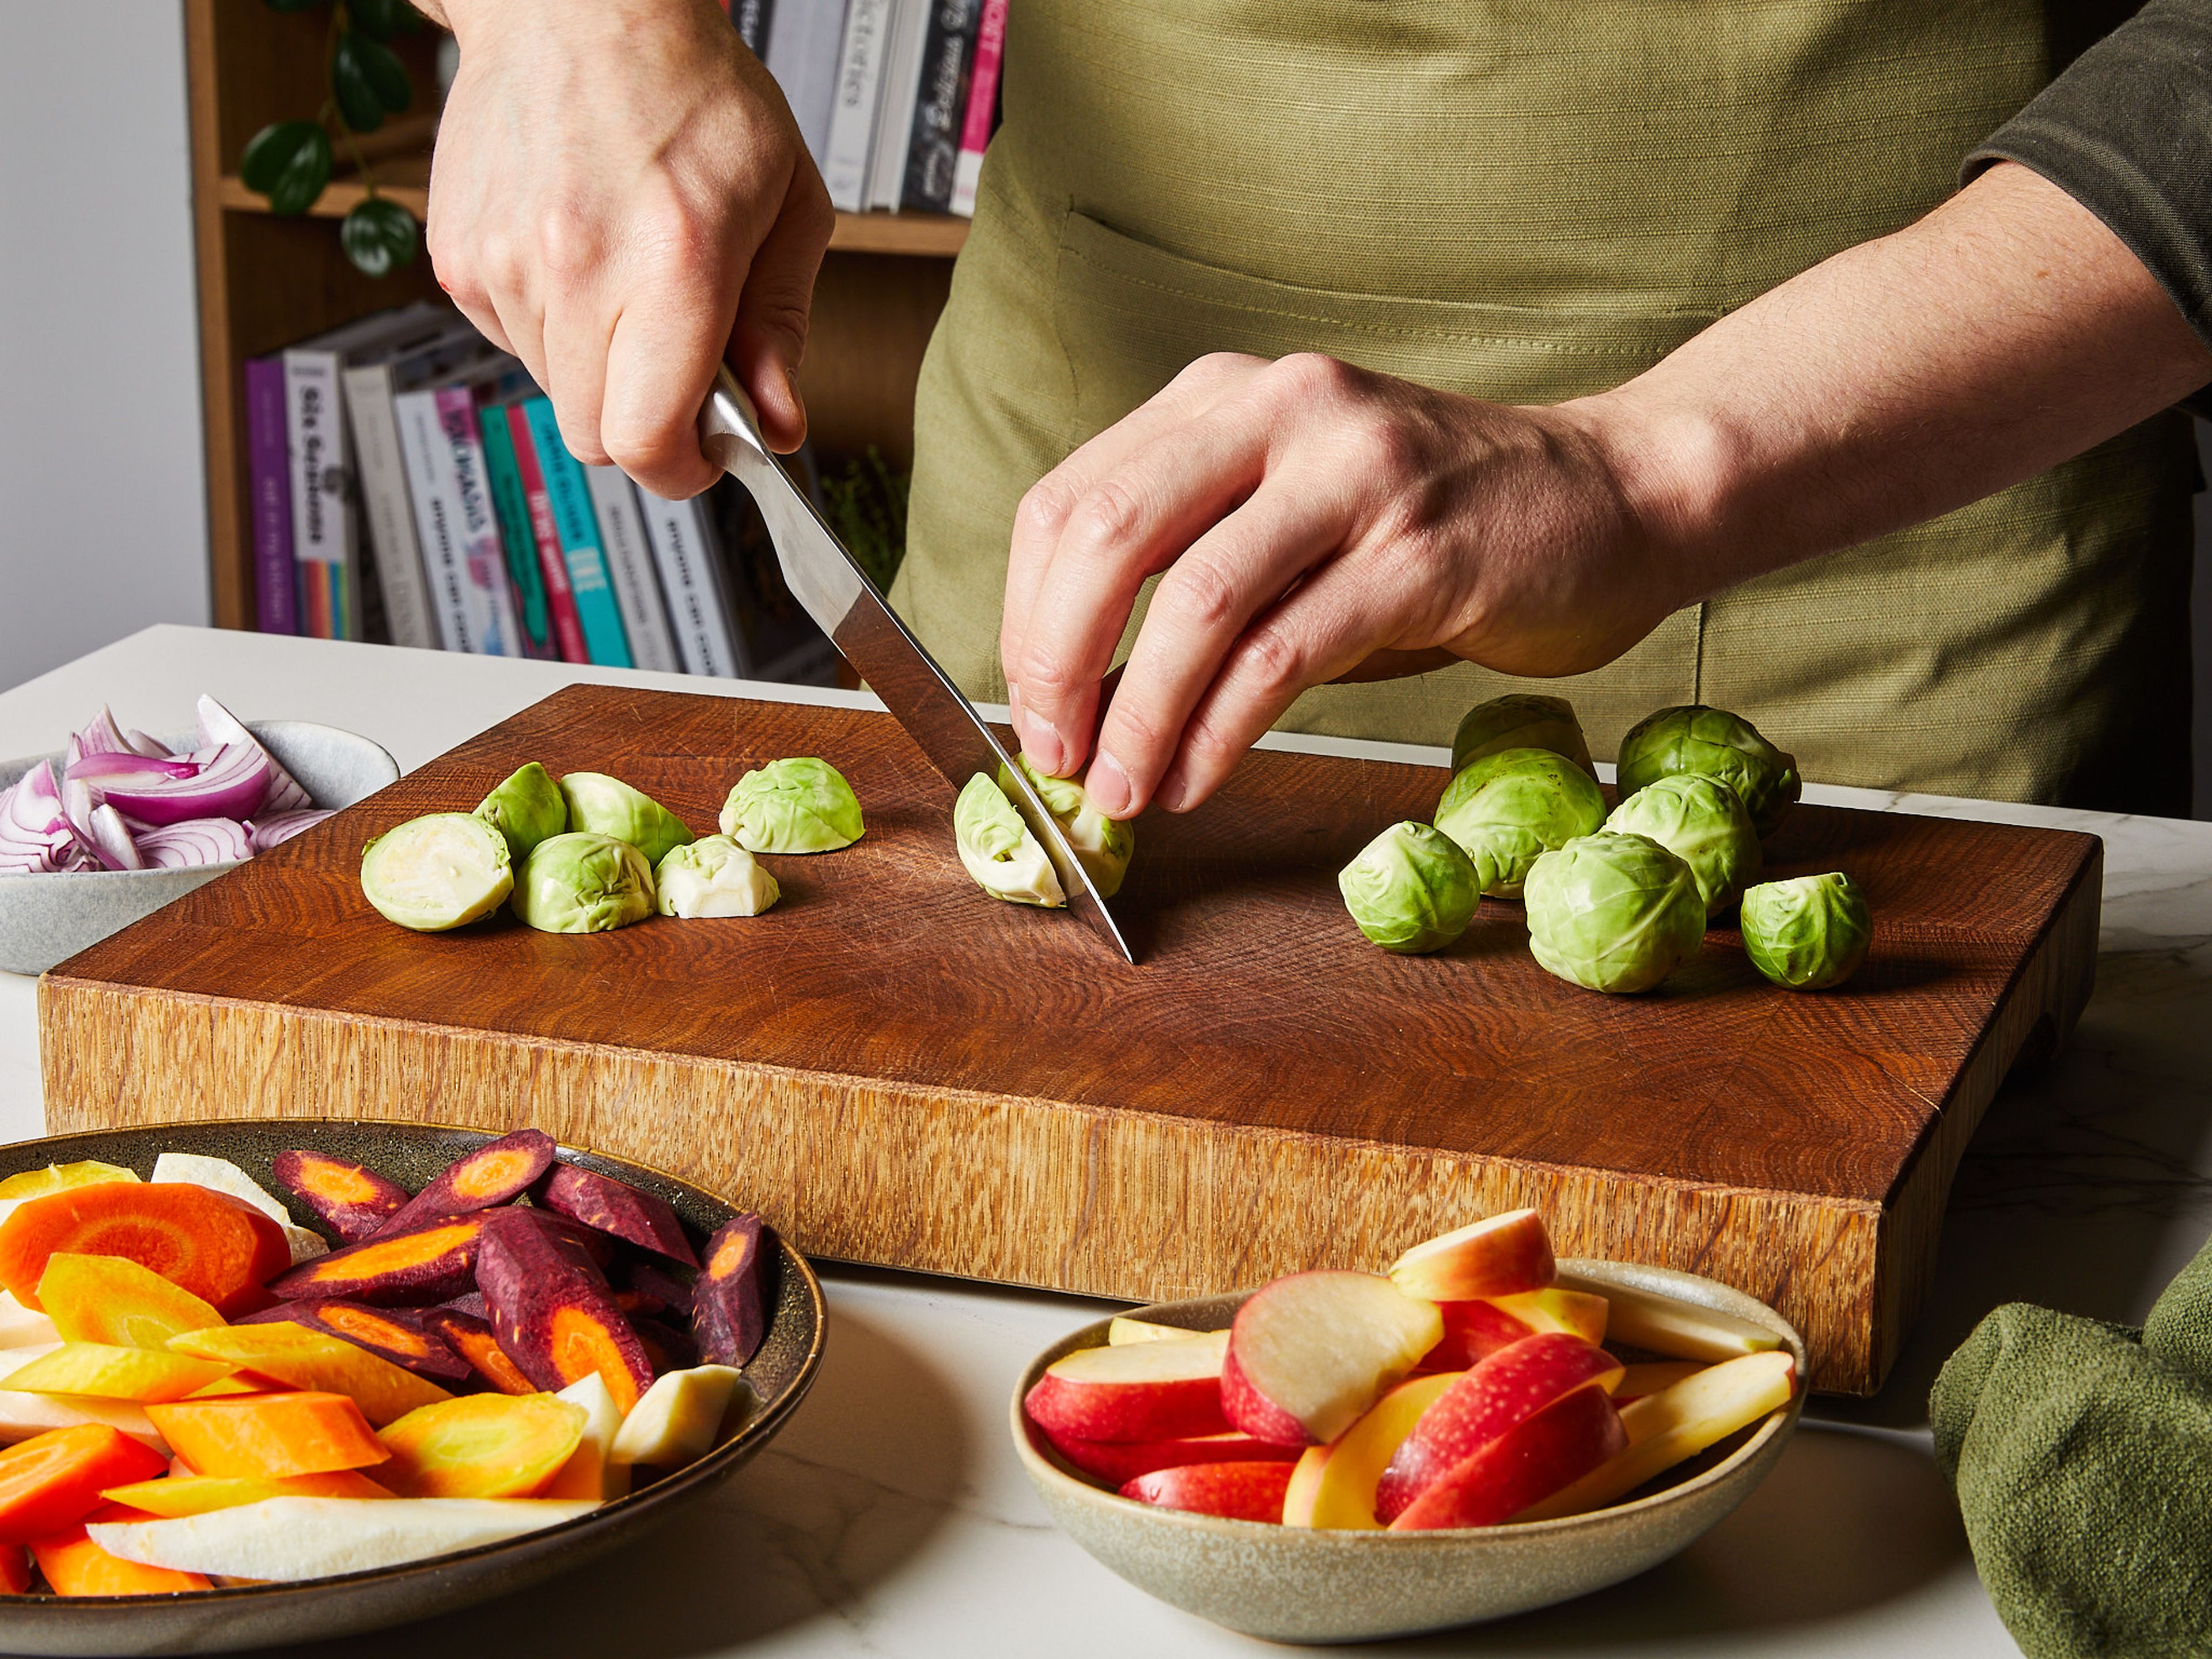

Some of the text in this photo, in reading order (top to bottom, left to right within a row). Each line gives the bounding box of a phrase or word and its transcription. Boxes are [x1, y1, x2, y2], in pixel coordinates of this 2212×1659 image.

[300, 386, 322, 429] Six
[302, 435, 327, 544] Seasons
[430, 497, 454, 567] anyone
[445, 570, 461, 604] can
[665, 519, 694, 589] anyone
[685, 593, 705, 629] can
